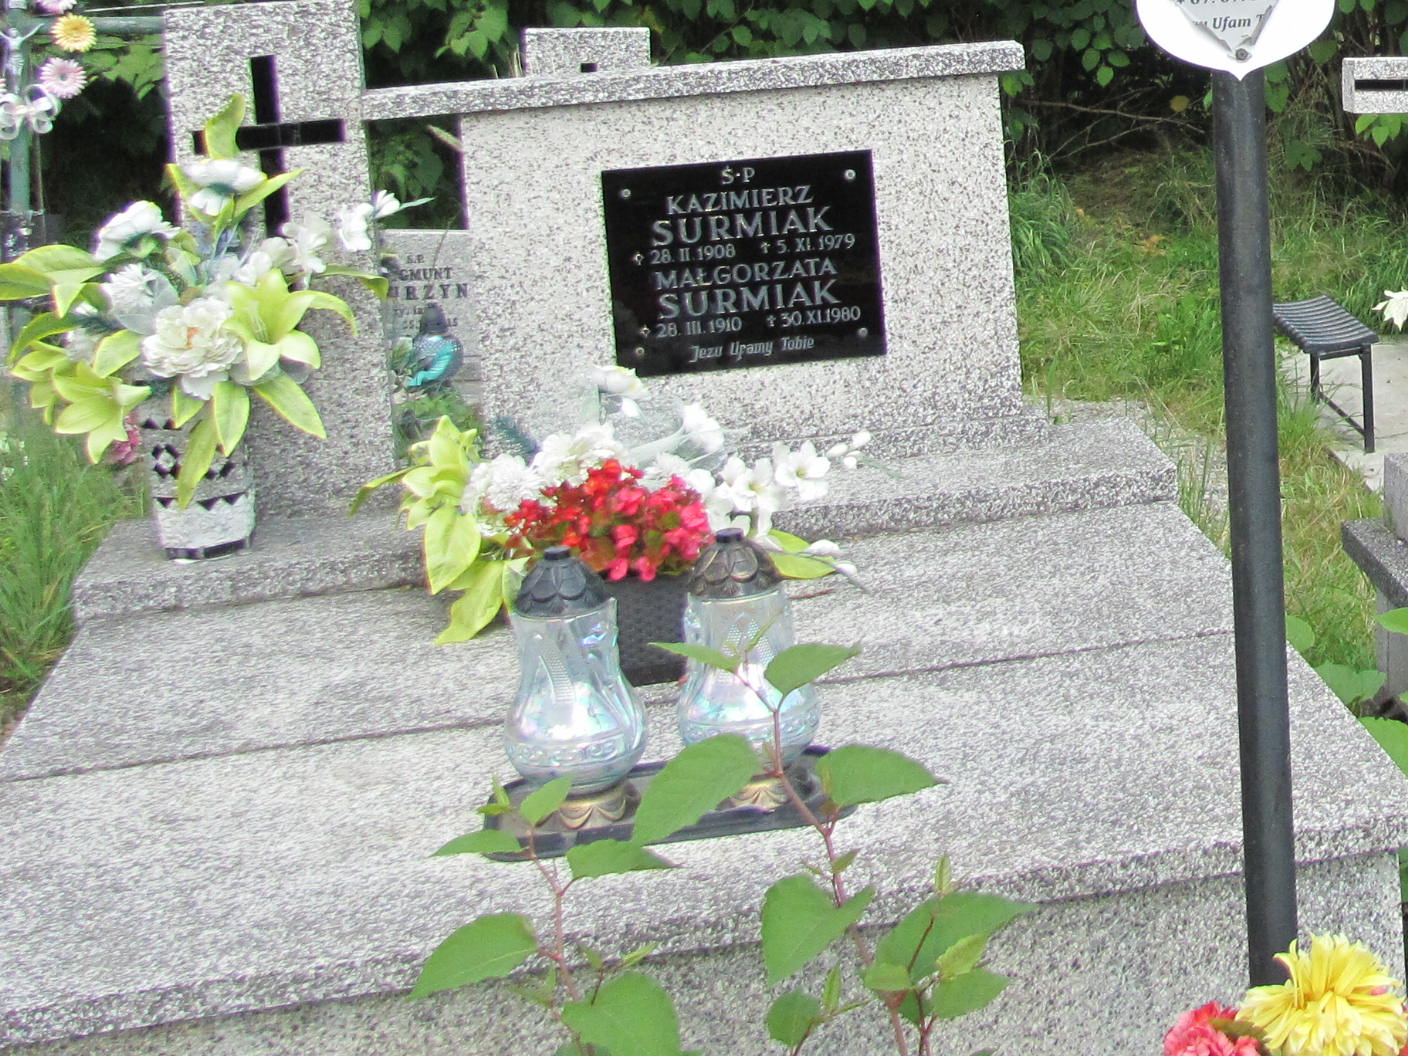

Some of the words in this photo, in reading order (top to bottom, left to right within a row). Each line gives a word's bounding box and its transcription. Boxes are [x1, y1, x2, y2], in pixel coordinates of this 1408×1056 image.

[1213, 16, 1251, 32] Ufam
[666, 185, 814, 215] KAZIMIERZ
[651, 206, 834, 247] SURMIAK
[697, 244, 736, 261] 1908
[819, 233, 855, 251] 1979
[654, 257, 838, 290] MAŁGORZATA
[657, 278, 842, 320] SURMIAK
[709, 317, 742, 334] 1910
[780, 336, 814, 352] Tobie
